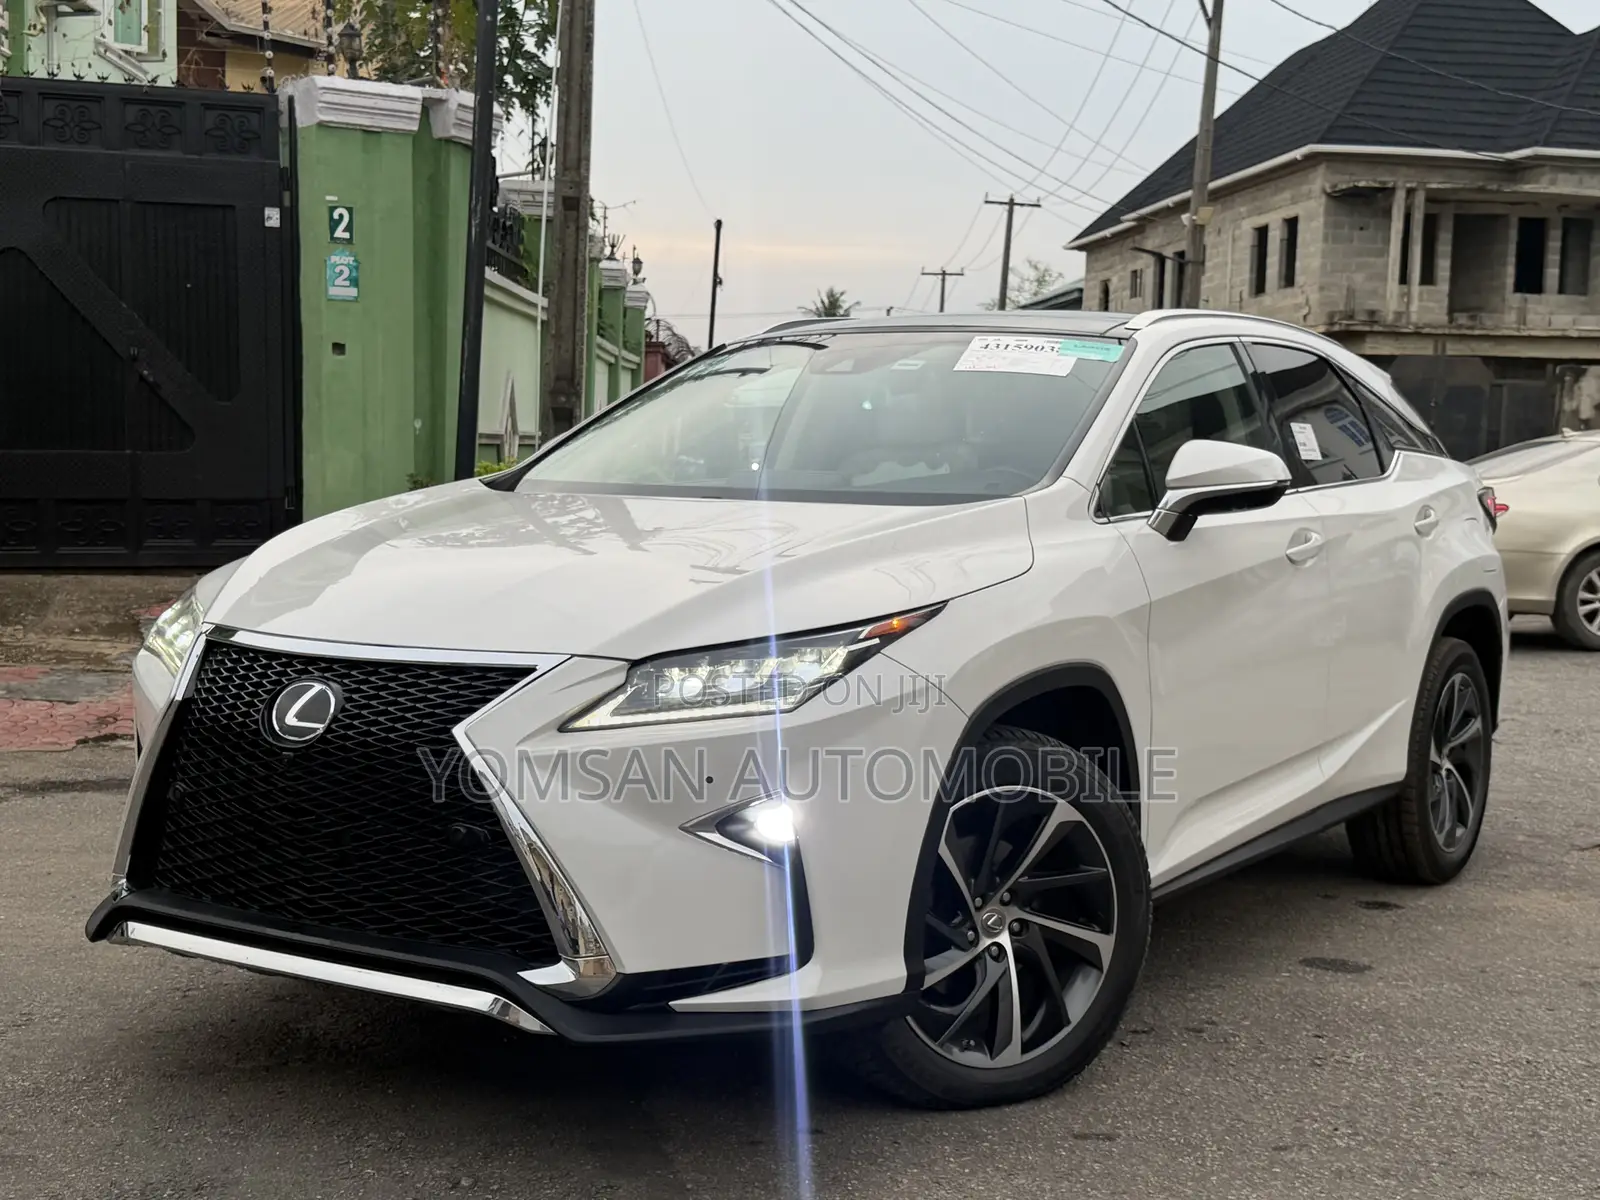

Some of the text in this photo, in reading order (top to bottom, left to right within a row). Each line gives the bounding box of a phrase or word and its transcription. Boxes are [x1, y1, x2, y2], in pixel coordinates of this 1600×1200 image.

[332, 207, 350, 239] 2
[330, 255, 355, 265] PLOT
[334, 264, 350, 287] 2
